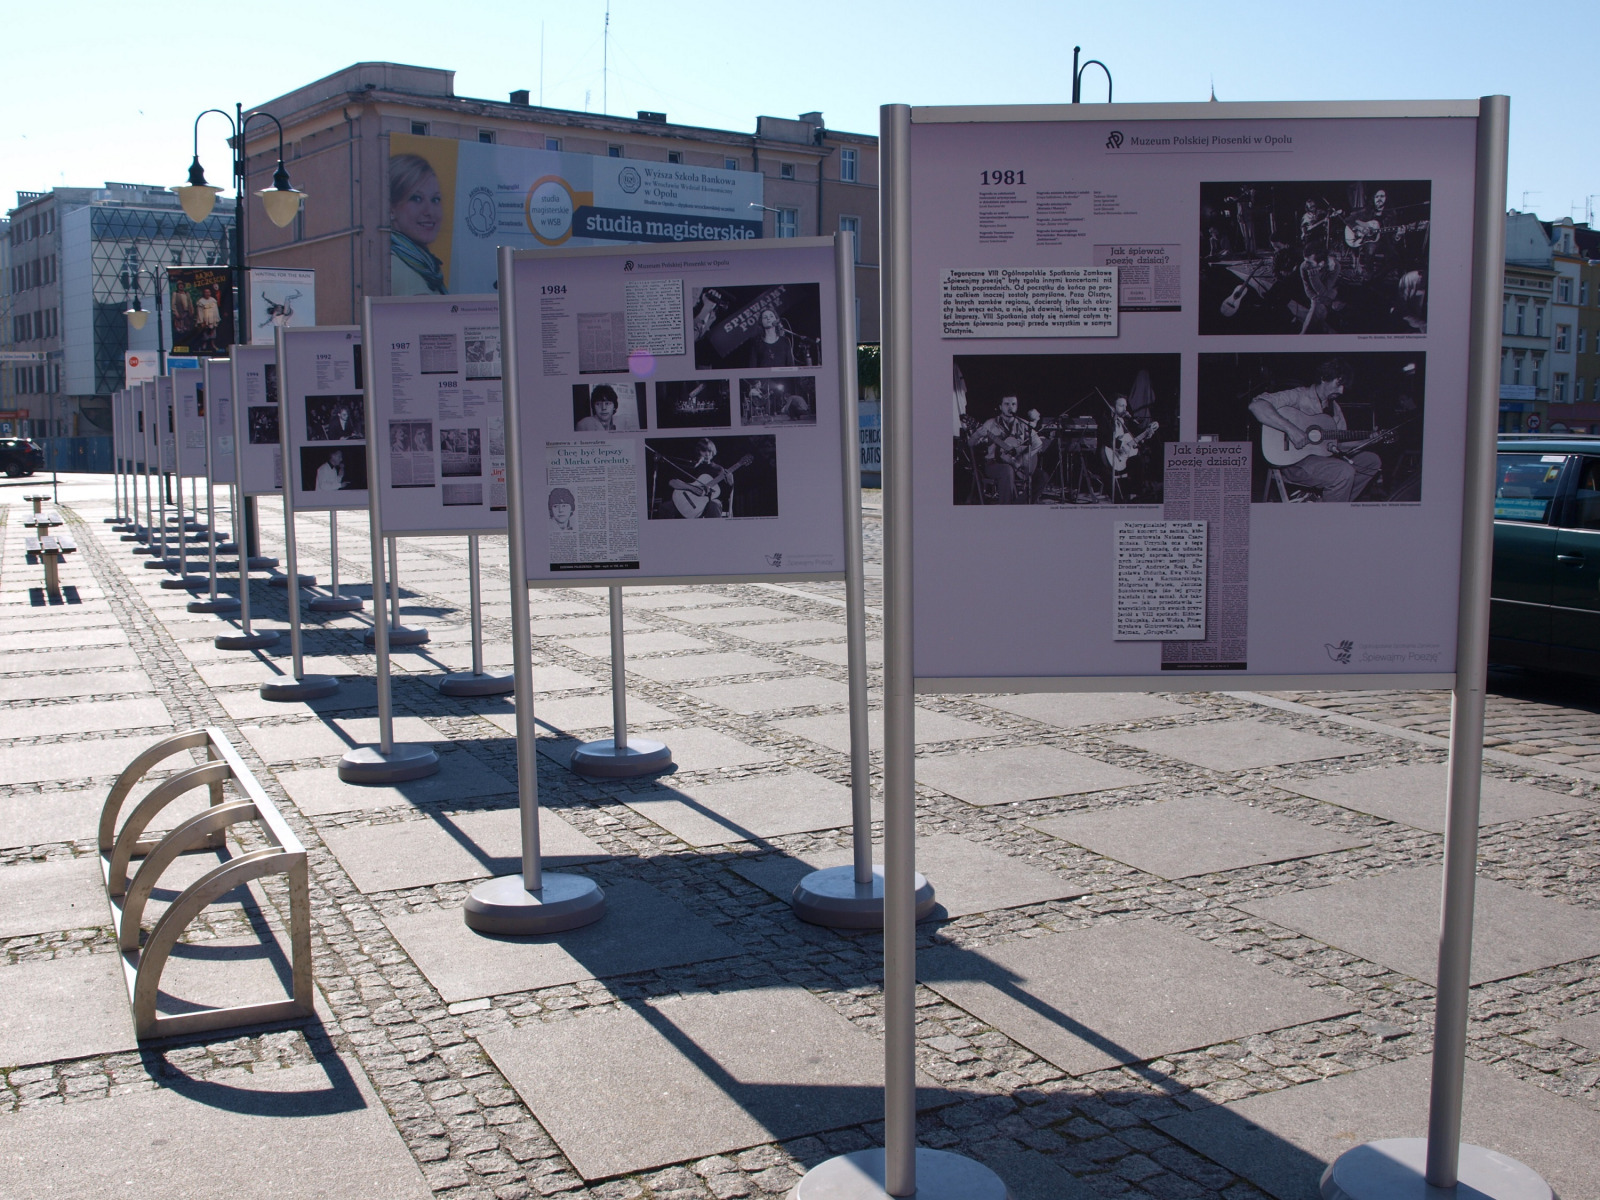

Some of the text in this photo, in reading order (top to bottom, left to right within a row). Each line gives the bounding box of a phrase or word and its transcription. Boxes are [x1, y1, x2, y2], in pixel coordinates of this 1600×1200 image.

[1130, 136, 1170, 145] Muzeum
[1174, 136, 1208, 146] Polskiej
[1212, 134, 1251, 144] Piosenki
[1264, 134, 1292, 146] Opolu
[644, 168, 672, 180] Wyższa
[702, 174, 736, 186] Bankowa
[980, 170, 1027, 185] 1981
[654, 189, 678, 200] Opolu
[532, 206, 569, 215] magisterskie
[586, 214, 755, 240] studia magisterskie
[1110, 247, 1164, 258] Jak śpiewać
[1106, 256, 1169, 266] poezję dzisiaj?
[541, 285, 567, 295] 1984
[580, 448, 595, 456] być
[598, 448, 622, 456] lepszy
[1173, 444, 1242, 458] Jak śpiewać
[1167, 456, 1247, 467] poezję dzisiaj?
